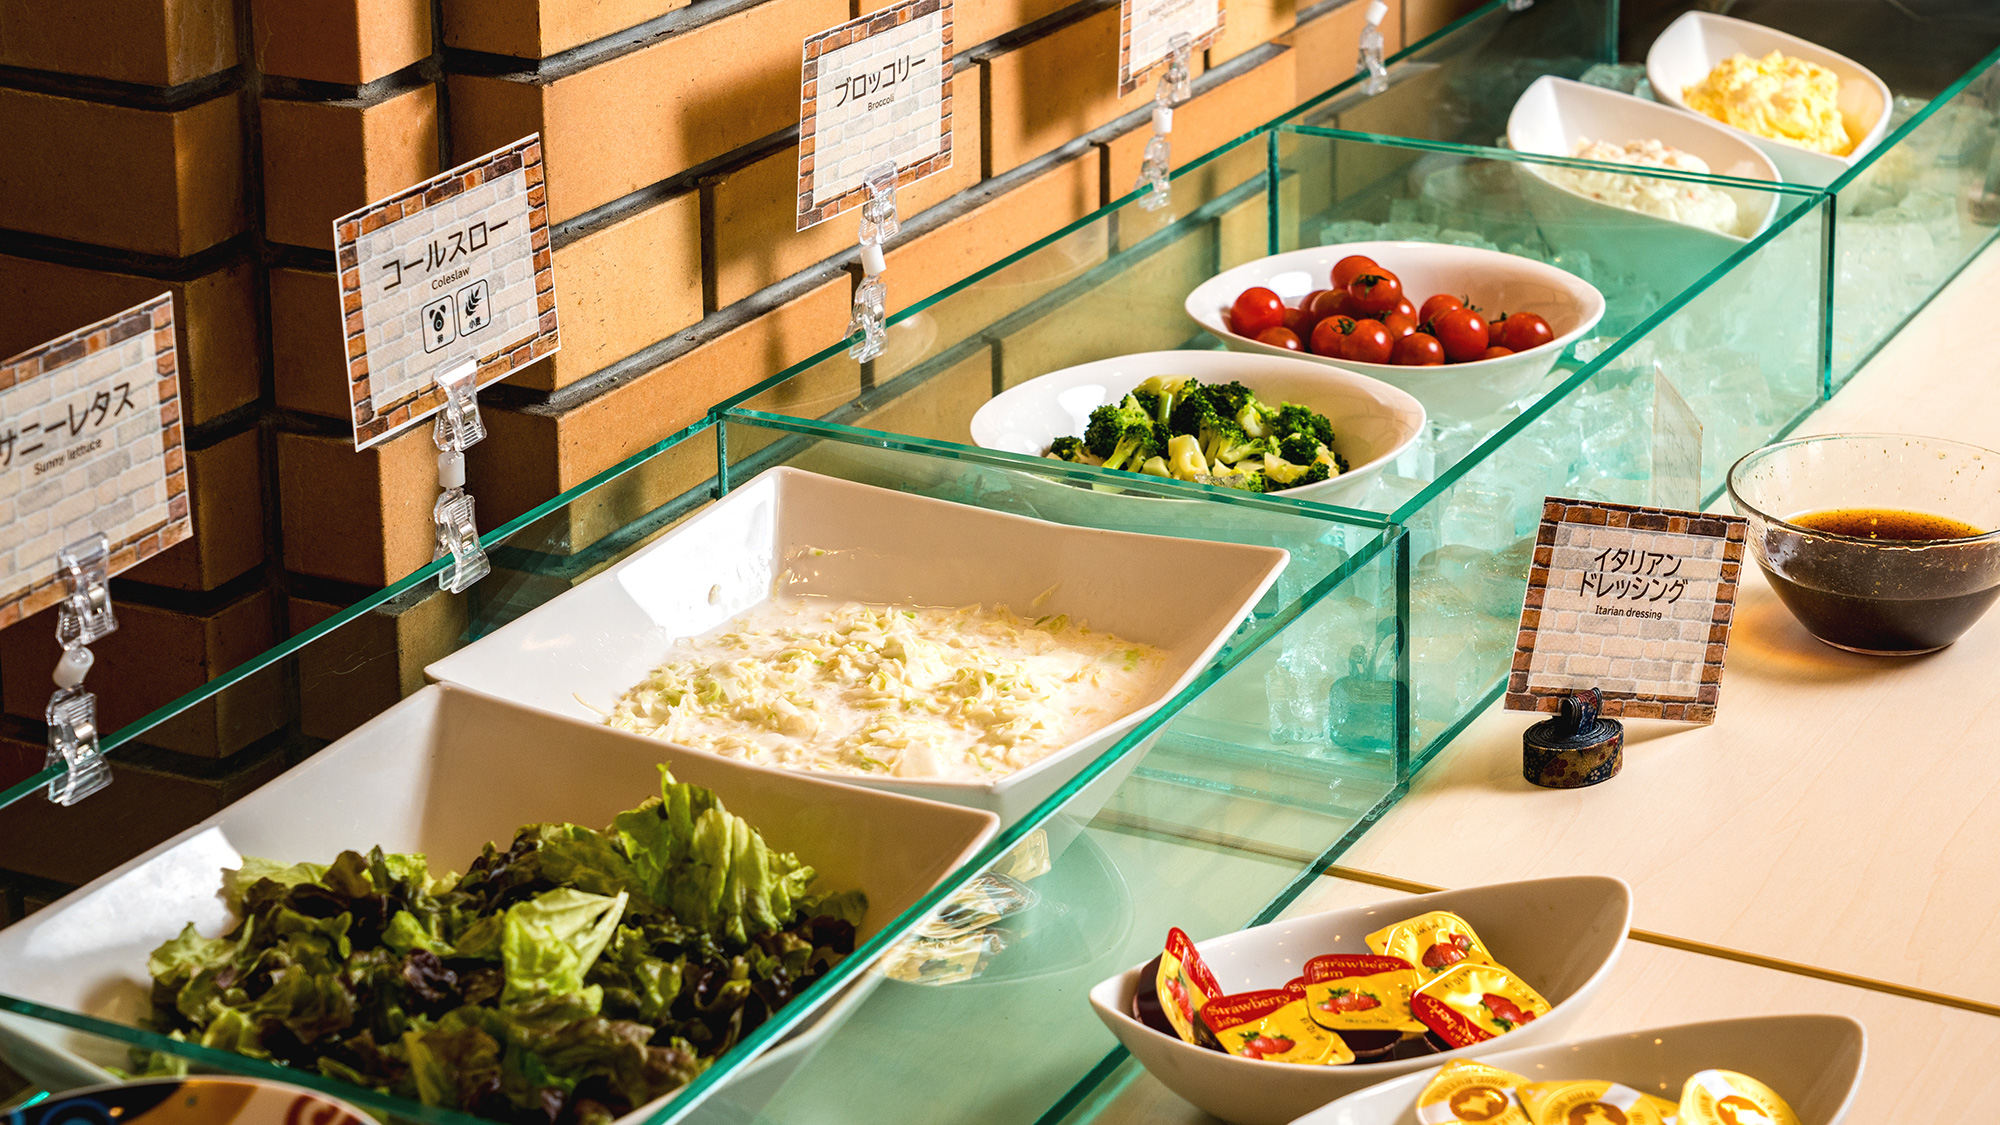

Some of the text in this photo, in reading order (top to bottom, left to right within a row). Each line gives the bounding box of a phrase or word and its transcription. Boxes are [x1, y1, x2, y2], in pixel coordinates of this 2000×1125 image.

[835, 55, 926, 107] ブロッコリー
[867, 93, 895, 112] Broccoli
[382, 220, 508, 291] コールスロー
[431, 267, 470, 290] Coleslaw
[33, 439, 103, 475] Sunny lettuce
[1594, 547, 1682, 577] イタリアン
[1580, 571, 1689, 604] ドレッシング
[1595, 605, 1663, 621] Itarian dressing
[1312, 960, 1401, 971] Strawberry
[1314, 970, 1344, 981] jam
[1206, 993, 1291, 1016] Strawberry
